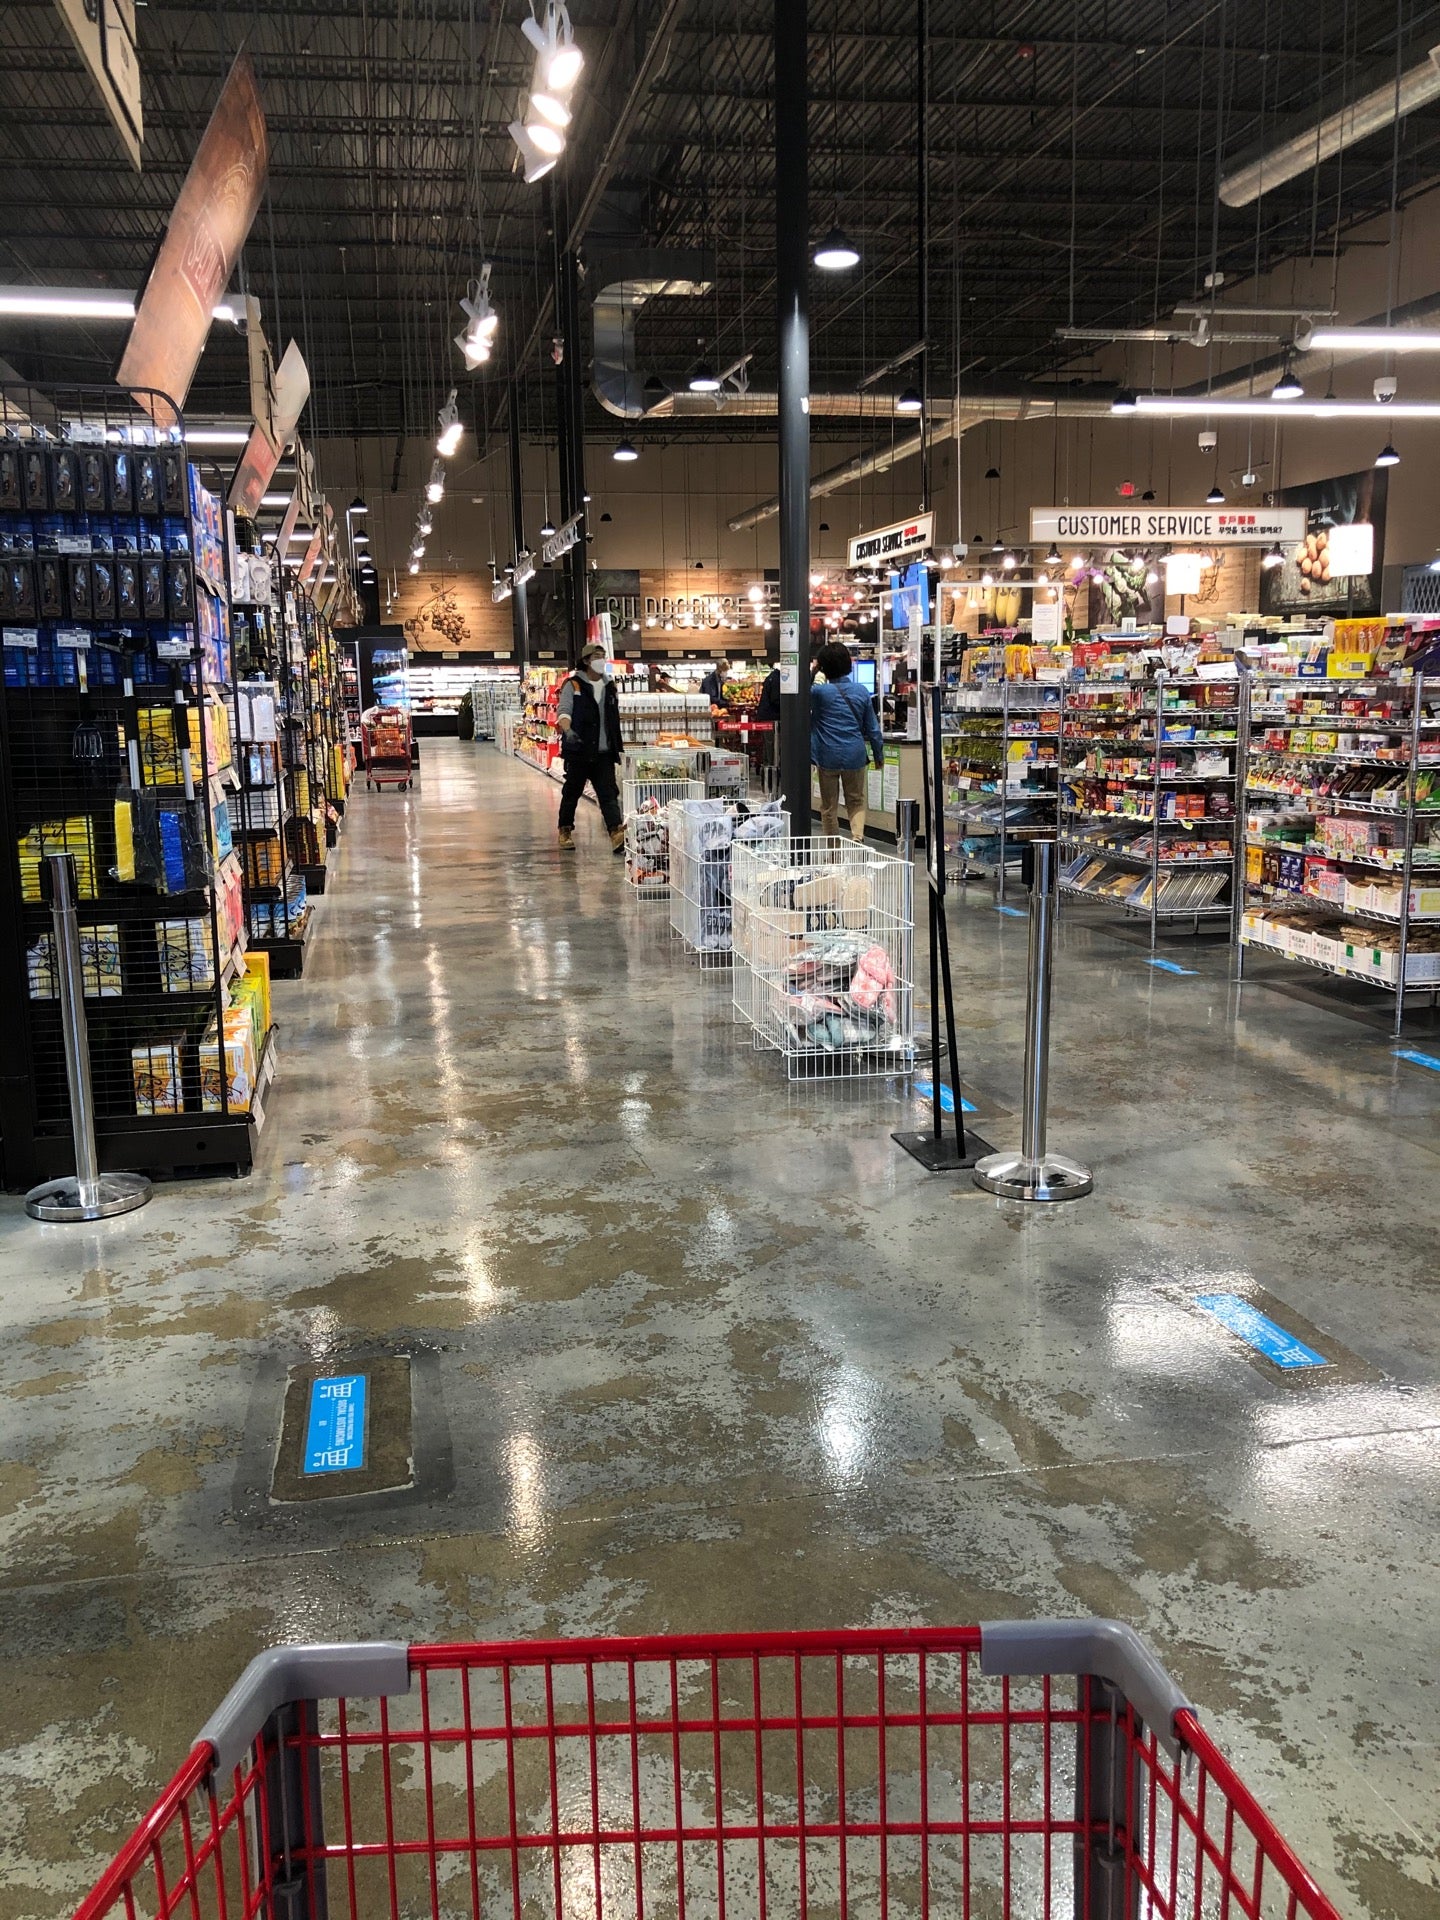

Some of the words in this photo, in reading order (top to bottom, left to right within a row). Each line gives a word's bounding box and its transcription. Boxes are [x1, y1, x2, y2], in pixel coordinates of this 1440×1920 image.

[1058, 515, 1140, 536] CUSTOMER
[1147, 515, 1213, 536] SERVICE
[856, 538, 882, 561] CUSTOMER
[882, 531, 904, 554] SERVICE
[645, 596, 748, 629] PRODUCE
[1322, 701, 1335, 709] DARS
[1341, 701, 1355, 709] DARS
[335, 1416, 347, 1446] DISTANCING
